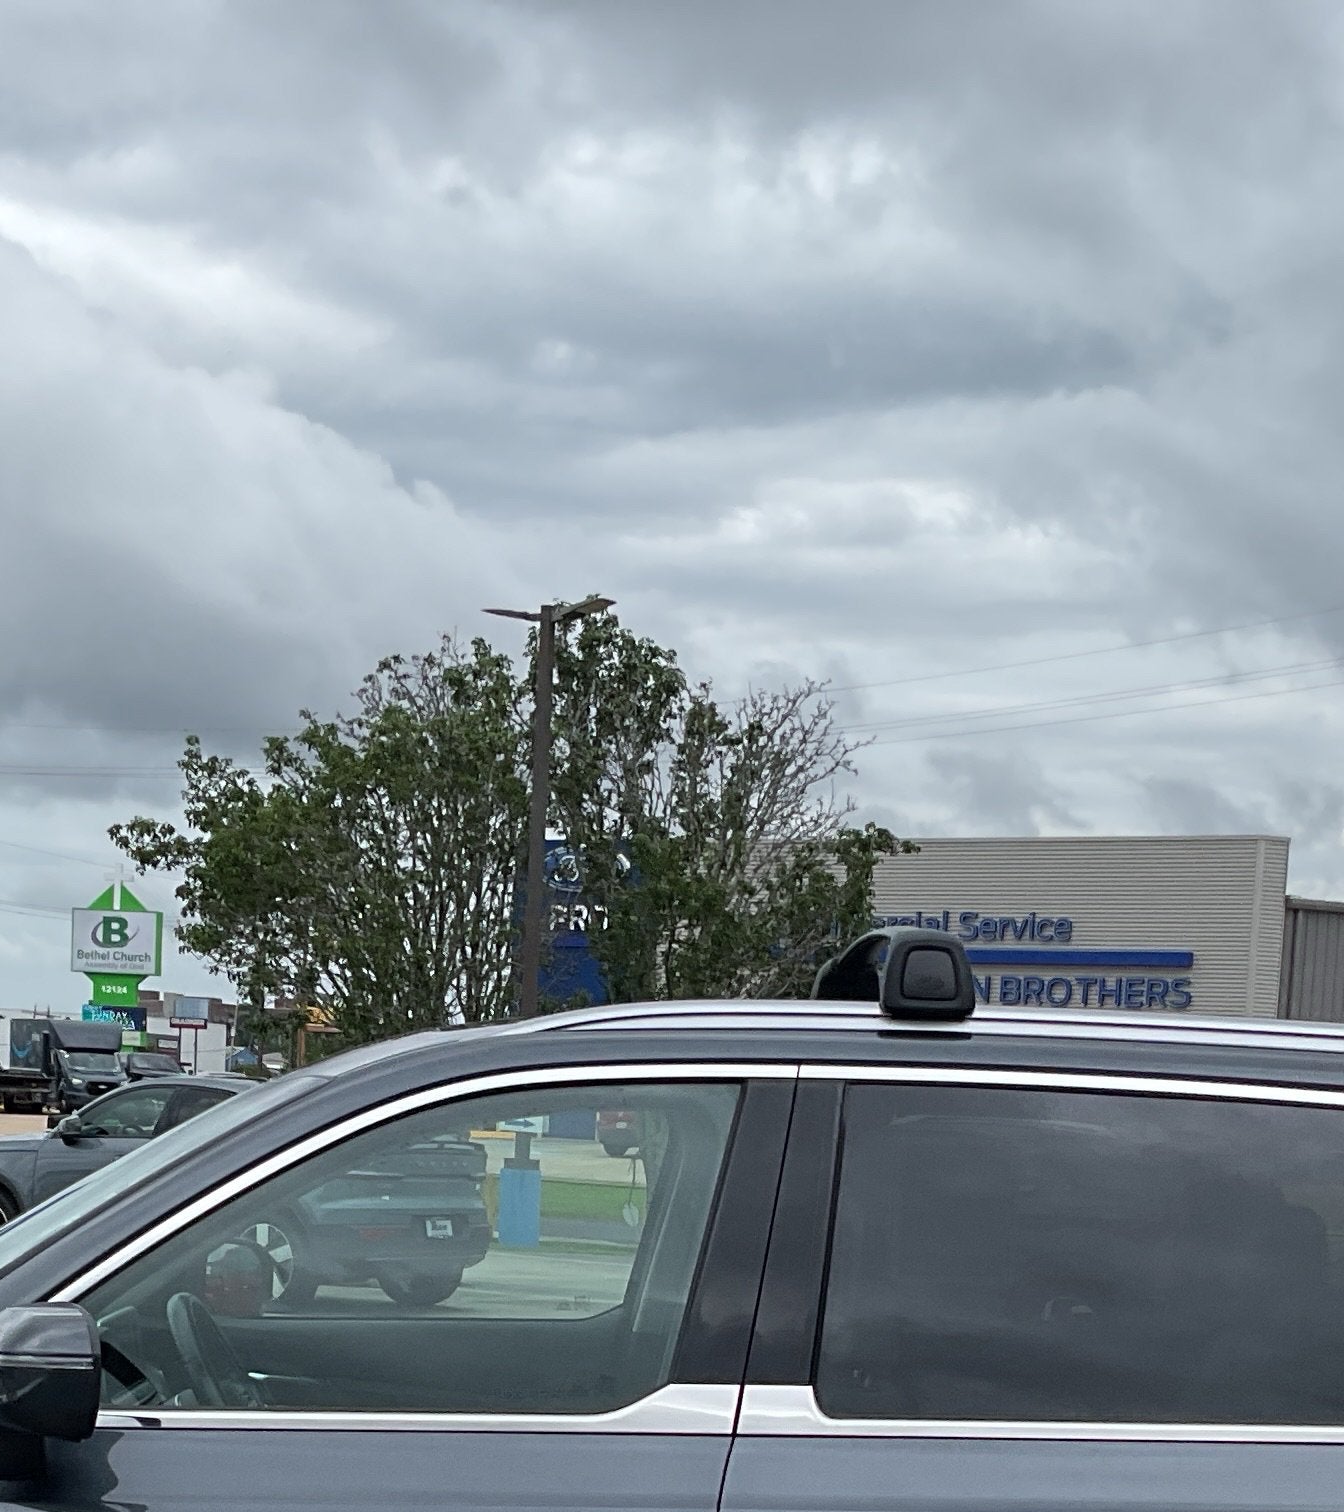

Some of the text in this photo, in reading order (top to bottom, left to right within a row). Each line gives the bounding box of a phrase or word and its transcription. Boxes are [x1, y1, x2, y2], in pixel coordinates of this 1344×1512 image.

[102, 915, 129, 946] B
[958, 911, 1073, 942] Service
[76, 949, 152, 963] Bethel Church
[999, 975, 1192, 1009] BROTHERS
